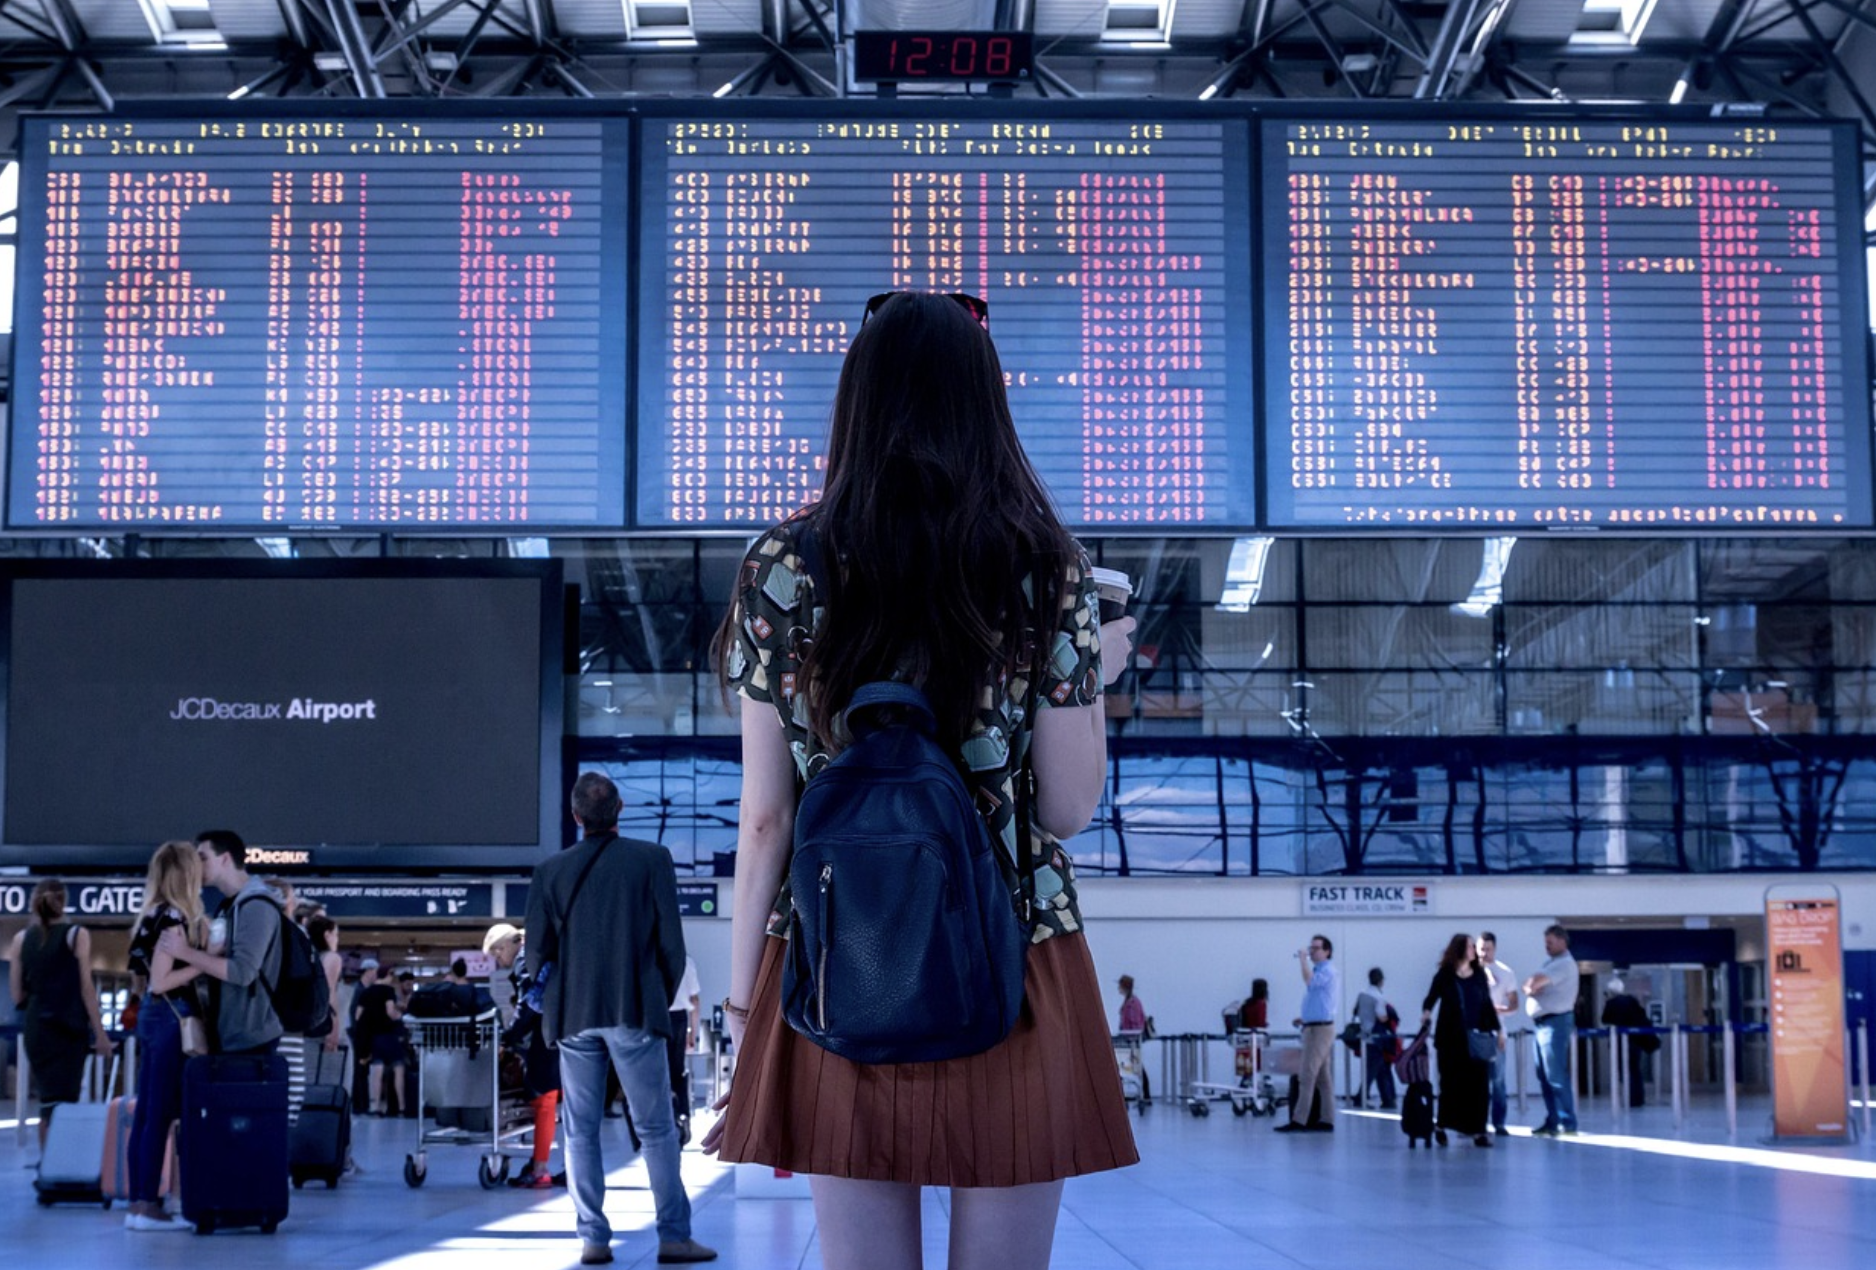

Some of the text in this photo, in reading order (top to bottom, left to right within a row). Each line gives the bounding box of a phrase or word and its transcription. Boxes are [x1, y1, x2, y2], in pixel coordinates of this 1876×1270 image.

[890, 38, 1012, 75] 12:08
[170, 698, 376, 723] JCDecaux Airport
[303, 887, 323, 897] YOUR
[324, 887, 363, 897] PASSPORT
[364, 887, 380, 897] AND
[382, 887, 420, 897] BOARDING
[442, 887, 467, 897] READY
[1309, 887, 1405, 901] FAST TRACK
